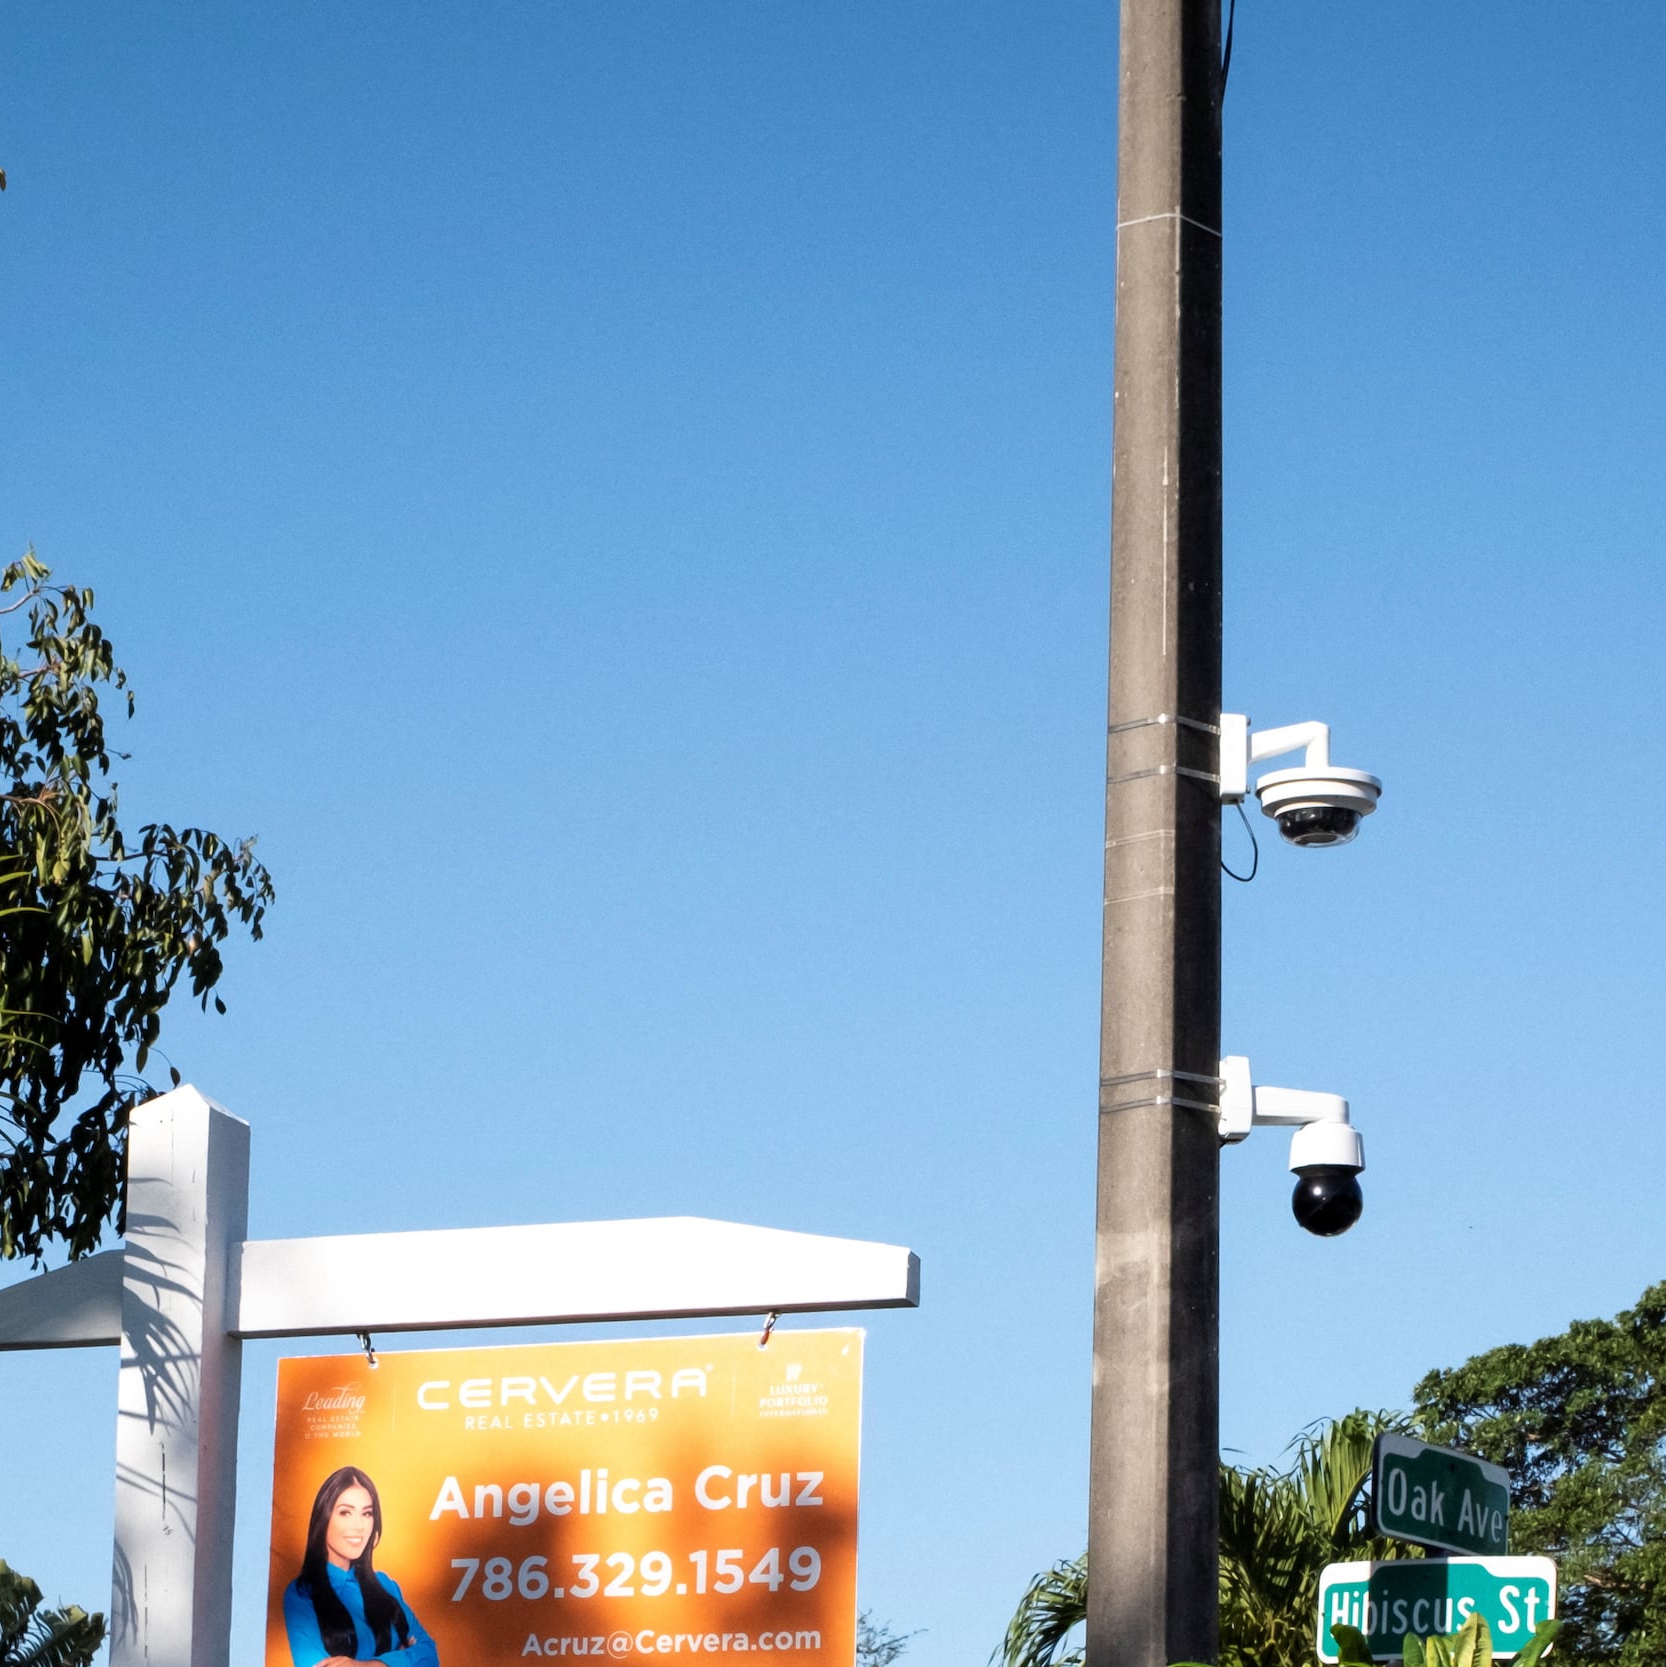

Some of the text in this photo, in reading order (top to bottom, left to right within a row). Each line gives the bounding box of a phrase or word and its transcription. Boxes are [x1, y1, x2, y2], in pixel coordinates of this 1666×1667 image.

[302, 1382, 365, 1414] Leading
[417, 1367, 707, 1410] CERVERA
[759, 1395, 828, 1408] PORTFOLIO
[769, 1383, 818, 1395] LUXURY
[465, 1414, 513, 1430] REAL
[429, 1464, 824, 1526] Angelica Cruz
[1388, 1468, 1503, 1543] Oak Ave
[450, 1545, 822, 1602] 786.329.1549
[1330, 1584, 1540, 1637] Hibiscus St
[521, 1629, 821, 1659] Acruz@Cervera.com
